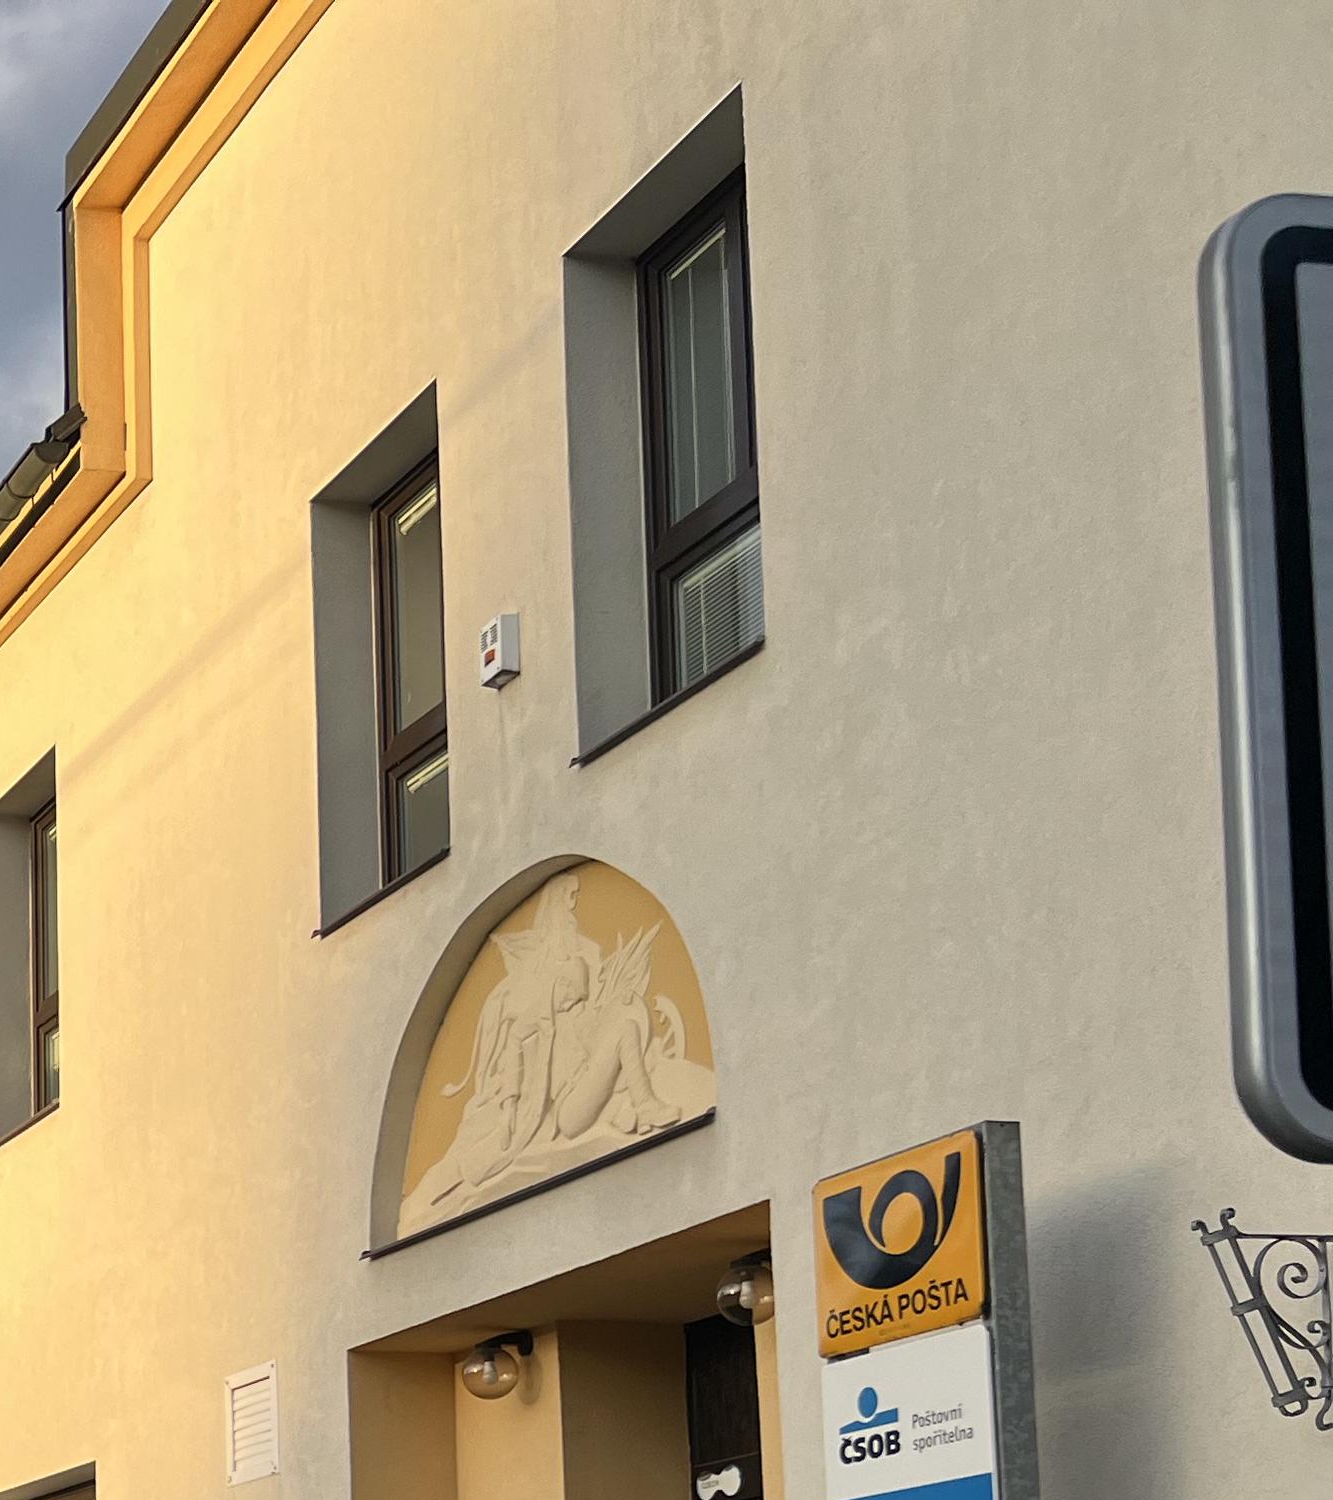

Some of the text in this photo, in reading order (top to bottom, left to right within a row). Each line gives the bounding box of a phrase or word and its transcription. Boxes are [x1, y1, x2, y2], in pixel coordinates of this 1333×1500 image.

[826, 1278, 969, 1339] ČESKÁ POŠTA
[912, 1404, 963, 1429] Poštovní
[839, 1430, 901, 1465] ČSOB
[913, 1426, 974, 1453] spořitelna
